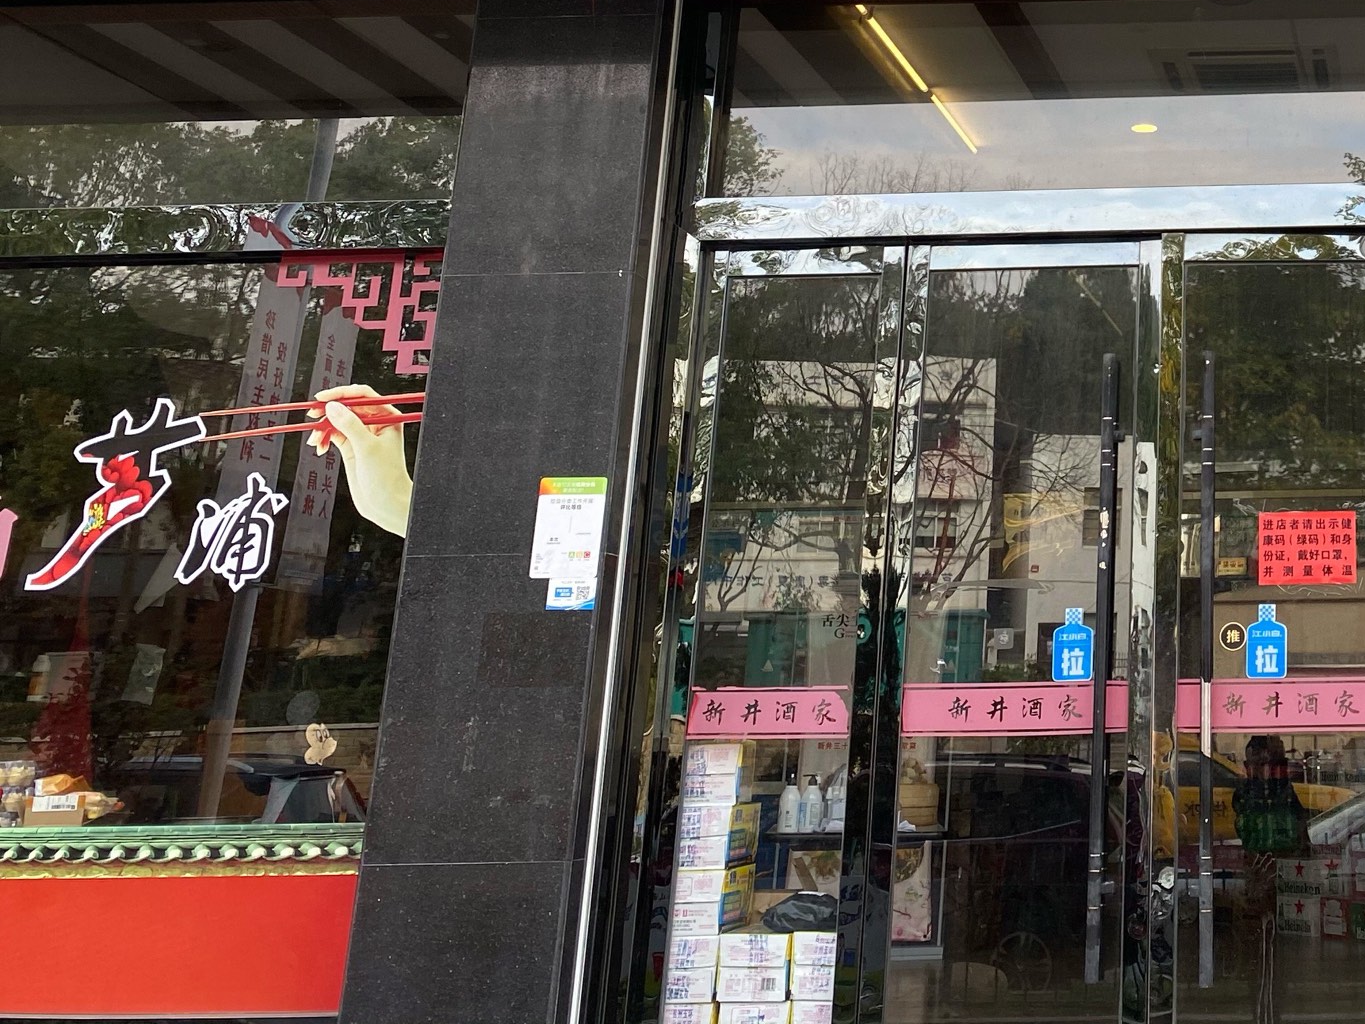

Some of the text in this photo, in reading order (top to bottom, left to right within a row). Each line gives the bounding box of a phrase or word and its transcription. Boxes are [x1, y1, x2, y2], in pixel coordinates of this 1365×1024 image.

[25, 398, 289, 592] 芦浦
[1263, 518, 1352, 530] 进店者请出示健
[1226, 629, 1240, 644] 推
[1061, 648, 1085, 677] 拉
[1255, 645, 1279, 673] 拉
[702, 698, 838, 725] 新井酒家
[947, 694, 1084, 722] 新井酒家
[1222, 689, 1361, 717] 新井酒家
